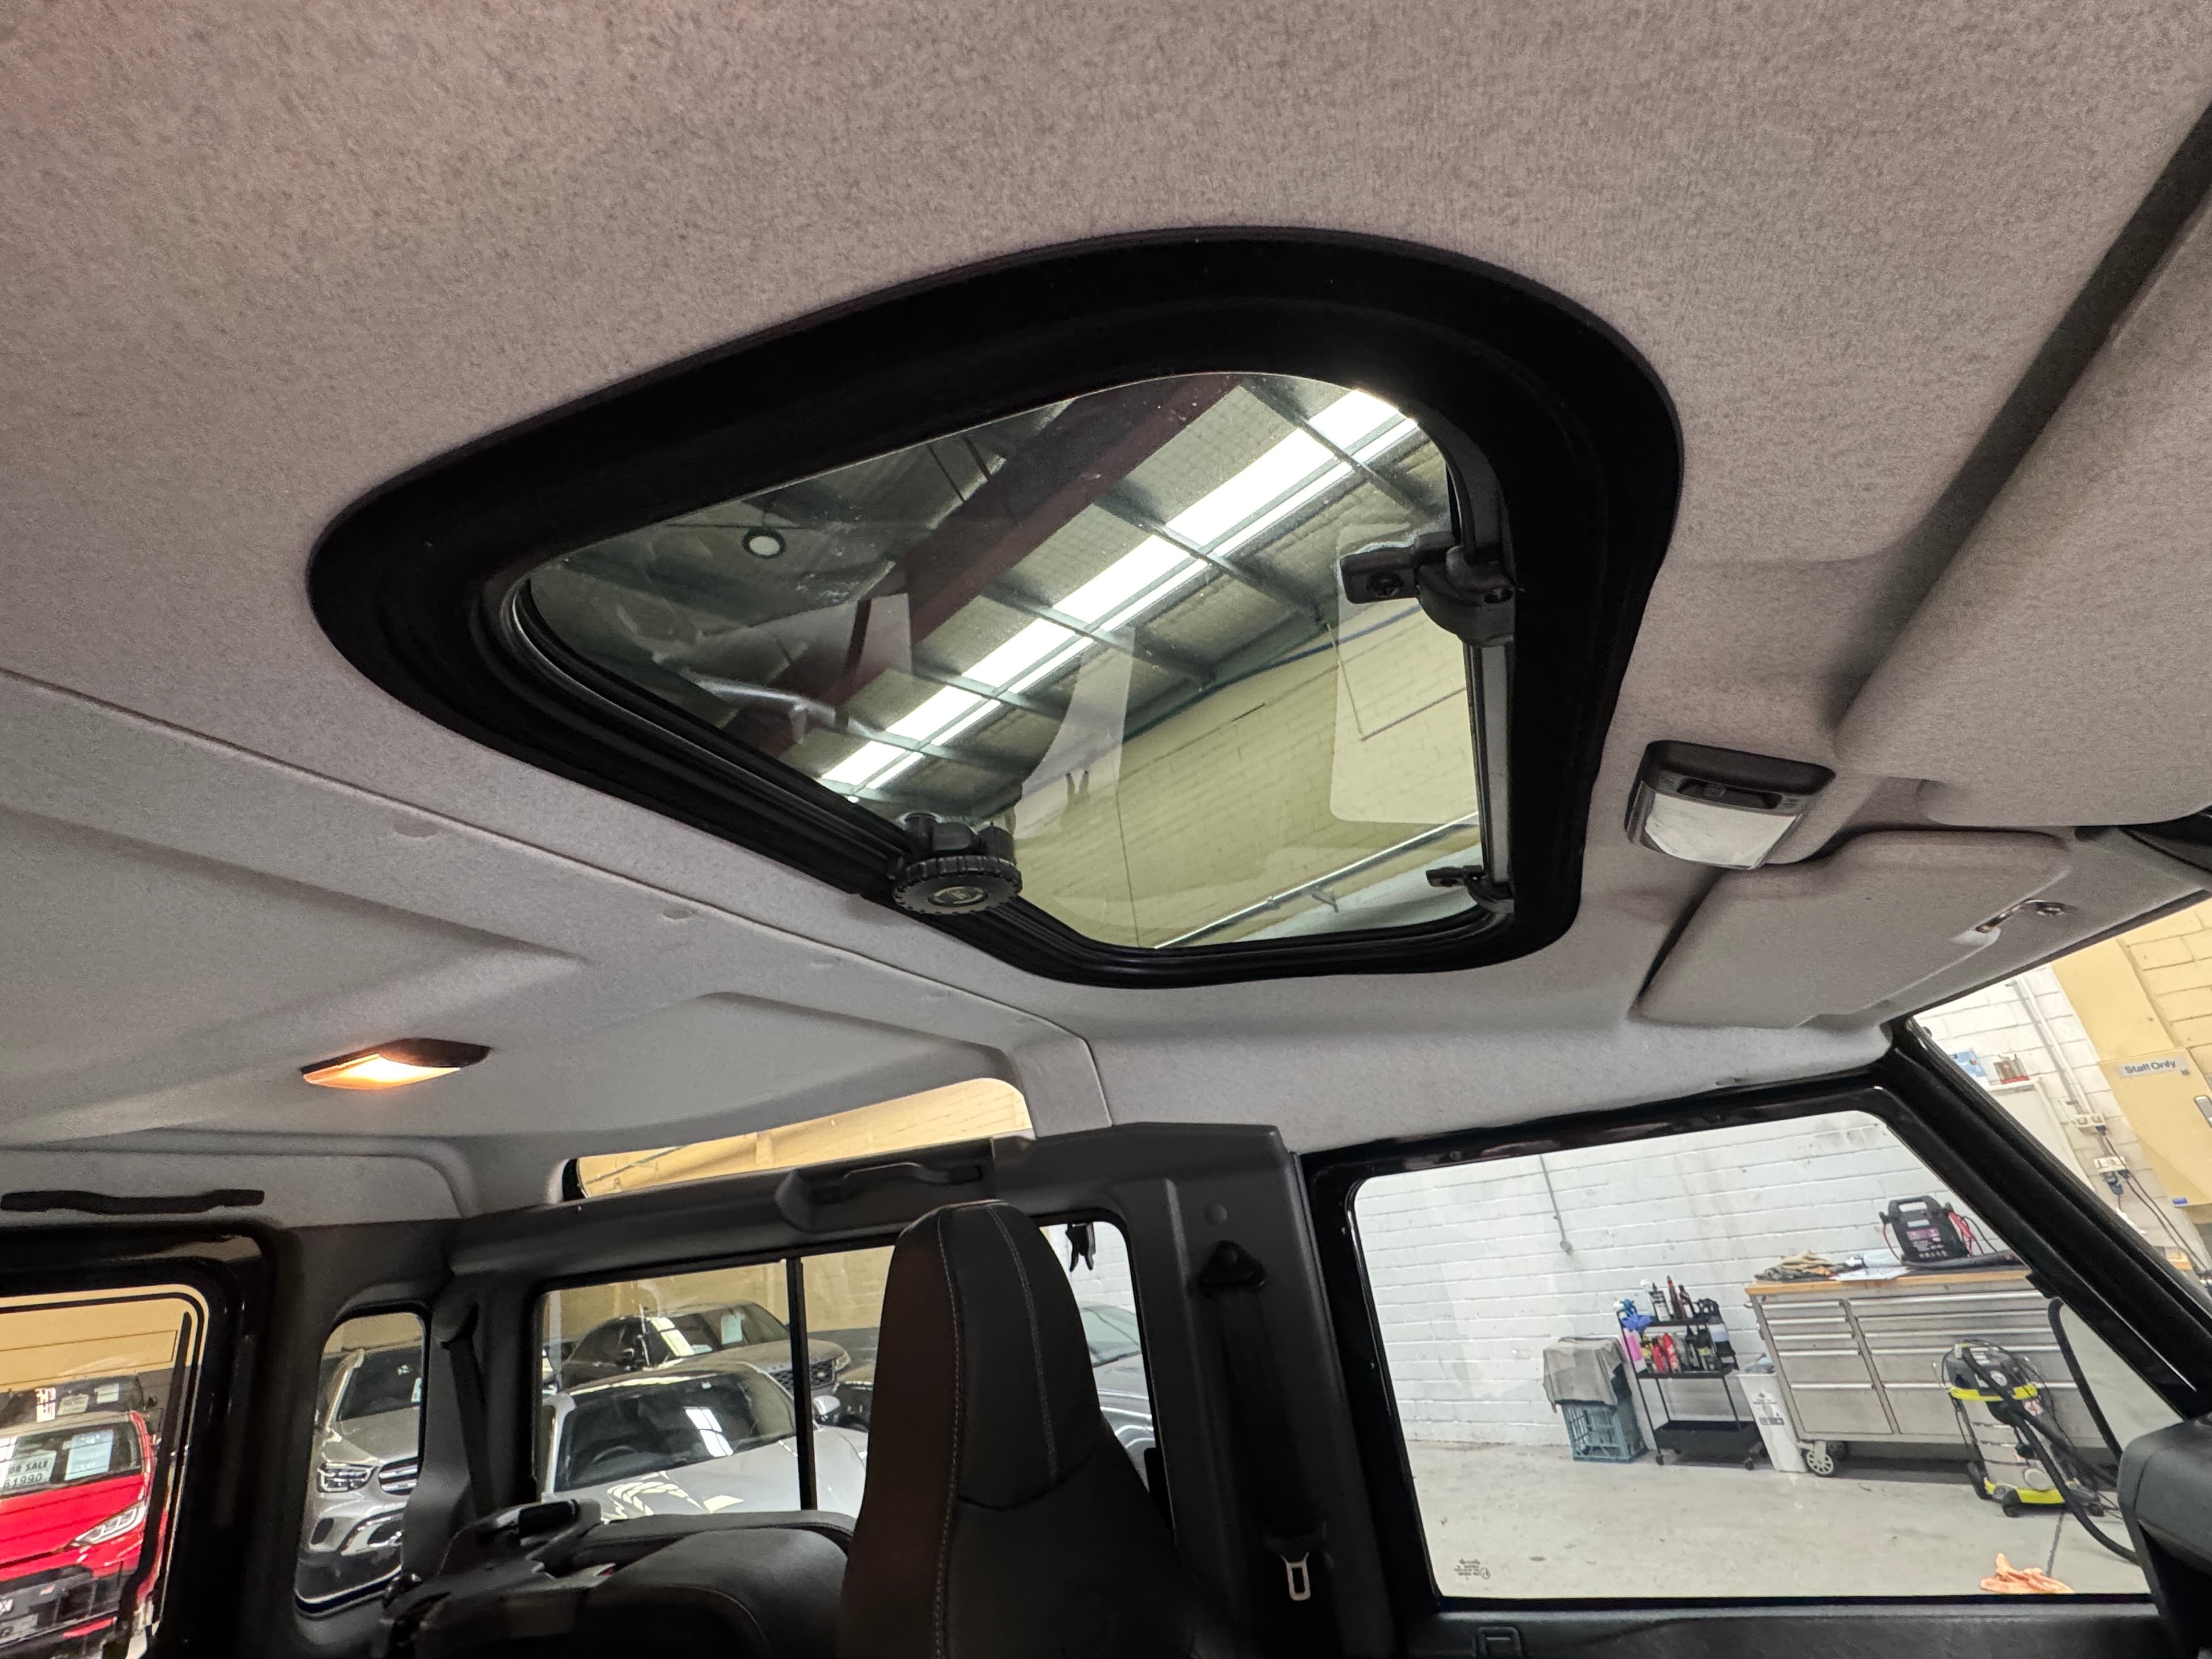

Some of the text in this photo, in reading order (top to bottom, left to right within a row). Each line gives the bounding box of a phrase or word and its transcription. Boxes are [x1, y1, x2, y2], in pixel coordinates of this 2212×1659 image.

[2124, 1060, 2176, 1074] Staff Only
[25, 1460, 48, 1472] SALE
